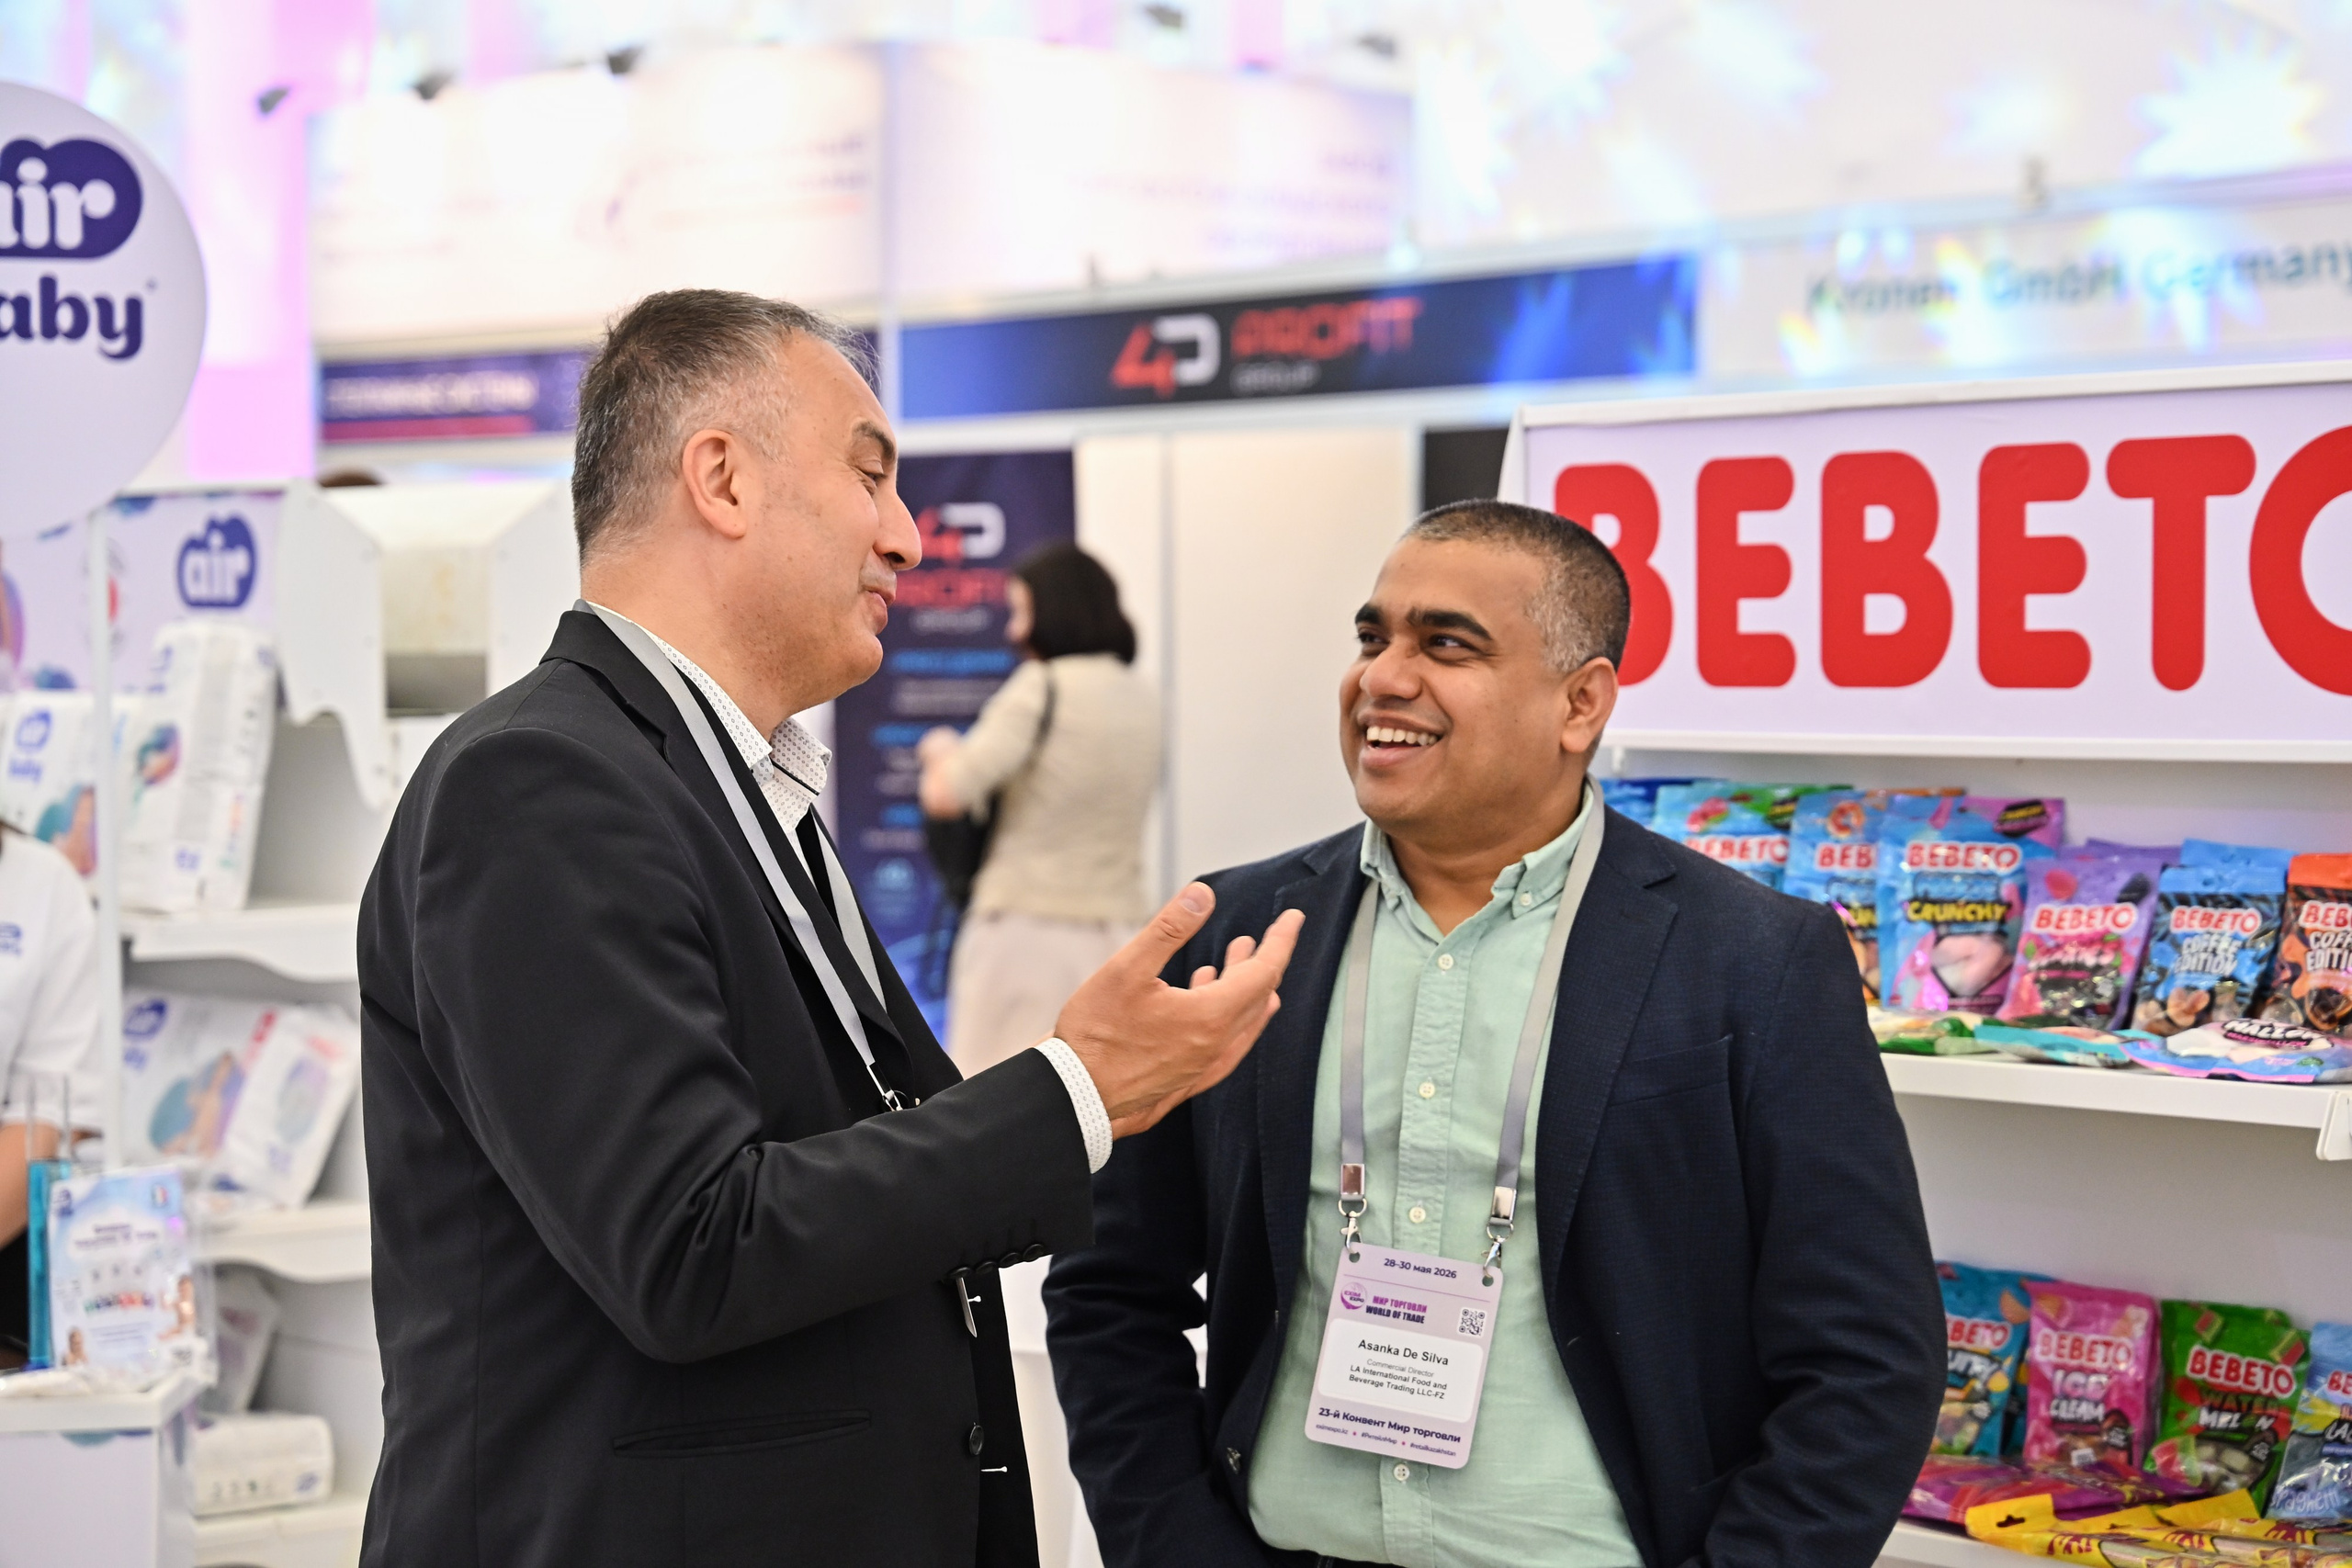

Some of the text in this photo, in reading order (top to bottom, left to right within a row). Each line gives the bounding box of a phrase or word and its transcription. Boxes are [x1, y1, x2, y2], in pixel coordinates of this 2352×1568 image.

[184, 528, 250, 597] air
[1907, 844, 2019, 870] BEBETO
[1907, 901, 2010, 923] CRUNCHY
[2035, 905, 2135, 930] BEBETO
[2172, 908, 2259, 933] BEBETO
[2303, 905, 2352, 928] BEB
[2307, 947, 2352, 972] EDITI
[1413, 1265, 1431, 1274] мая
[1434, 1267, 1457, 1279] 2026
[1365, 1304, 1425, 1324] WORLD OF TRADE
[1373, 1295, 1427, 1313] МИР ТОРГОВЛИ
[1358, 1339, 1449, 1365] Asanka De Silva
[2039, 1332, 2132, 1370] BEBETO
[1363, 1367, 1409, 1382] International
[1411, 1377, 1430, 1386] Food
[1432, 1381, 1447, 1390] and
[1366, 1359, 1434, 1378] Commercial Director
[2188, 1348, 2294, 1395] BEBETO
[1349, 1373, 1445, 1399] Beverage Trading LLC-FZ
[1316, 1424, 1349, 1435] eximexpo.kz
[1318, 1407, 1461, 1443] 23-й Конвент Мир торговли
